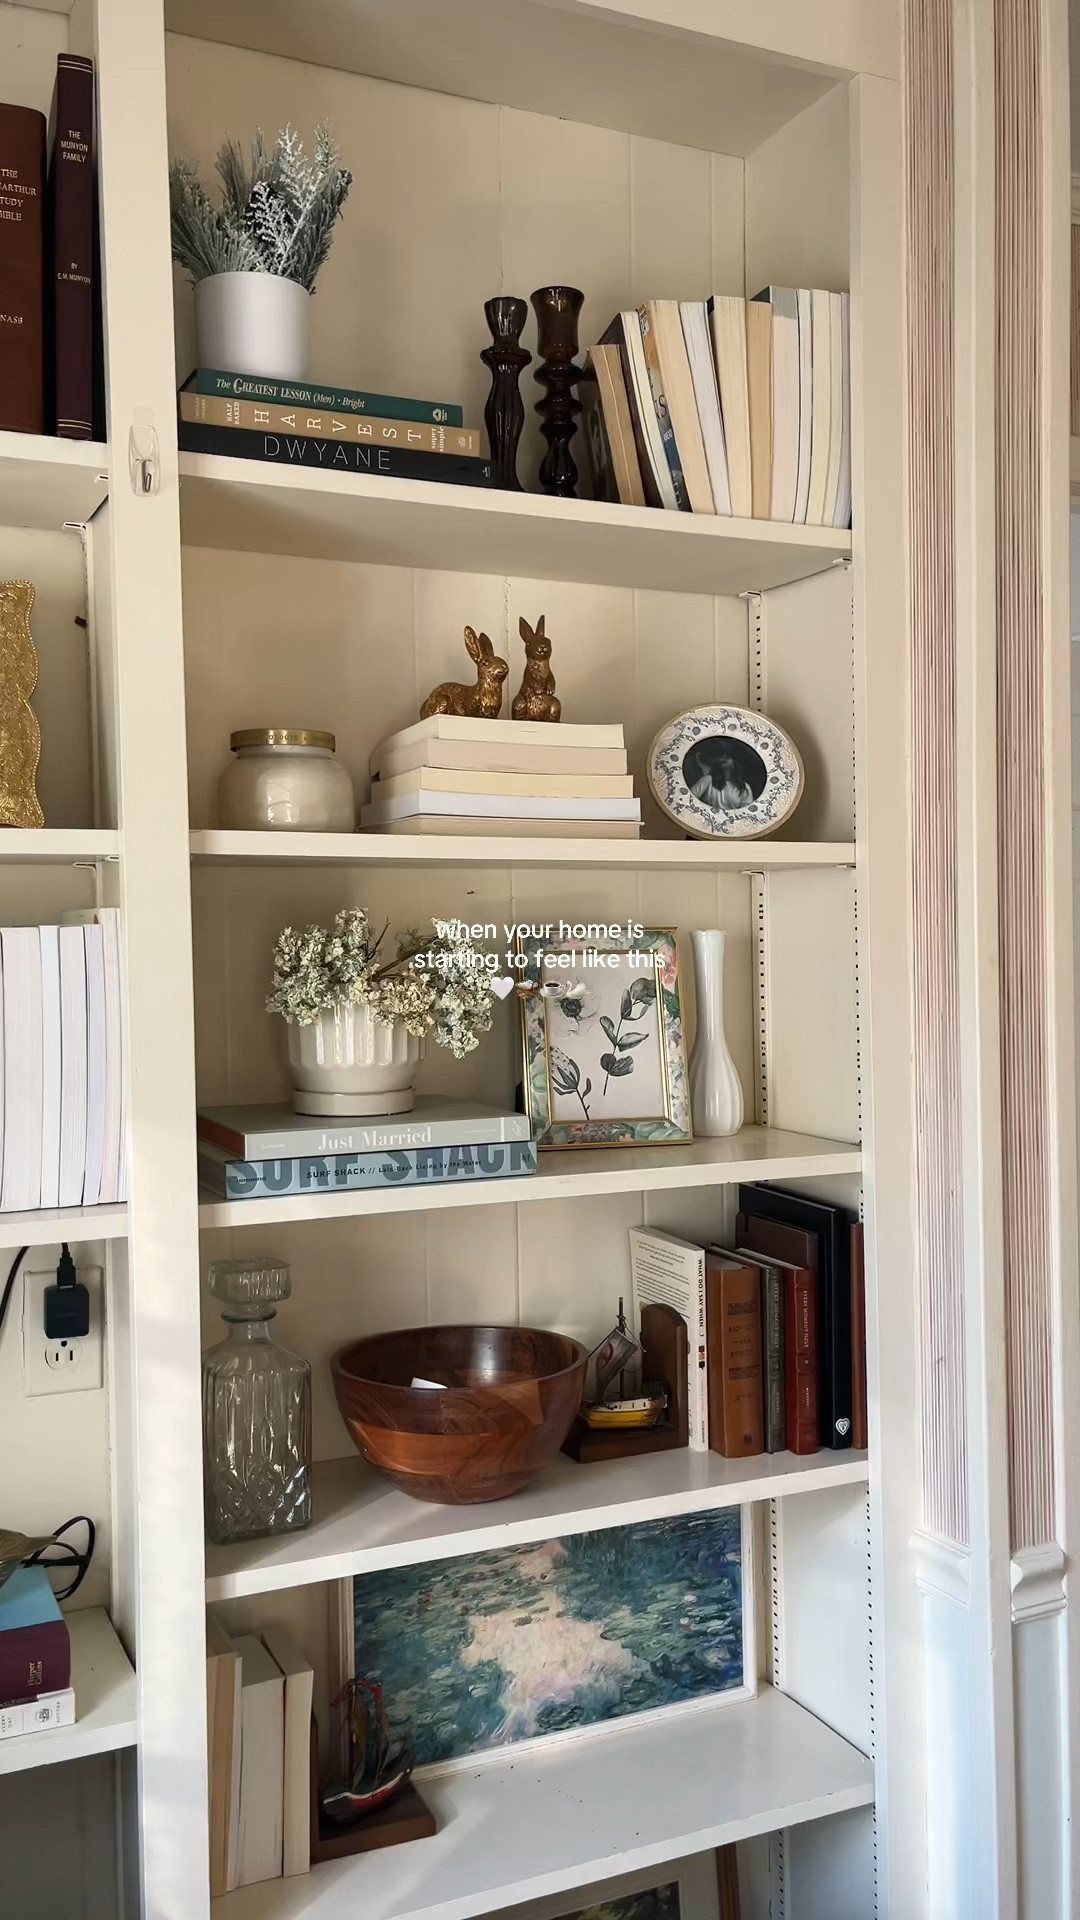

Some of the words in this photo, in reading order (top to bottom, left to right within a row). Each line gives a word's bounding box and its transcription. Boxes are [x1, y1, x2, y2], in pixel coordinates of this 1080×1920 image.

[68, 130, 81, 140] THE
[60, 140, 88, 152] MUNYON
[62, 152, 86, 163] FAMILY
[1, 168, 18, 178] THE
[0, 182, 37, 196] ARTHUR
[0, 196, 24, 207] TUDY
[69, 274, 91, 284] MUNYON
[216, 378, 231, 389] The
[233, 378, 278, 397] GREATEST
[281, 388, 311, 401] LESSON
[313, 392, 336, 405] (Men)
[342, 397, 365, 410] Bright
[254, 409, 422, 442] HARVEST
[264, 435, 391, 470] DWYANE
[318, 1134, 353, 1151] Just
[362, 1126, 432, 1146] Married
[306, 1170, 331, 1179] SURF
[334, 1167, 366, 1177] SHACK
[698, 1279, 703, 1289] DO
[27, 1662, 36, 1686] Harper
